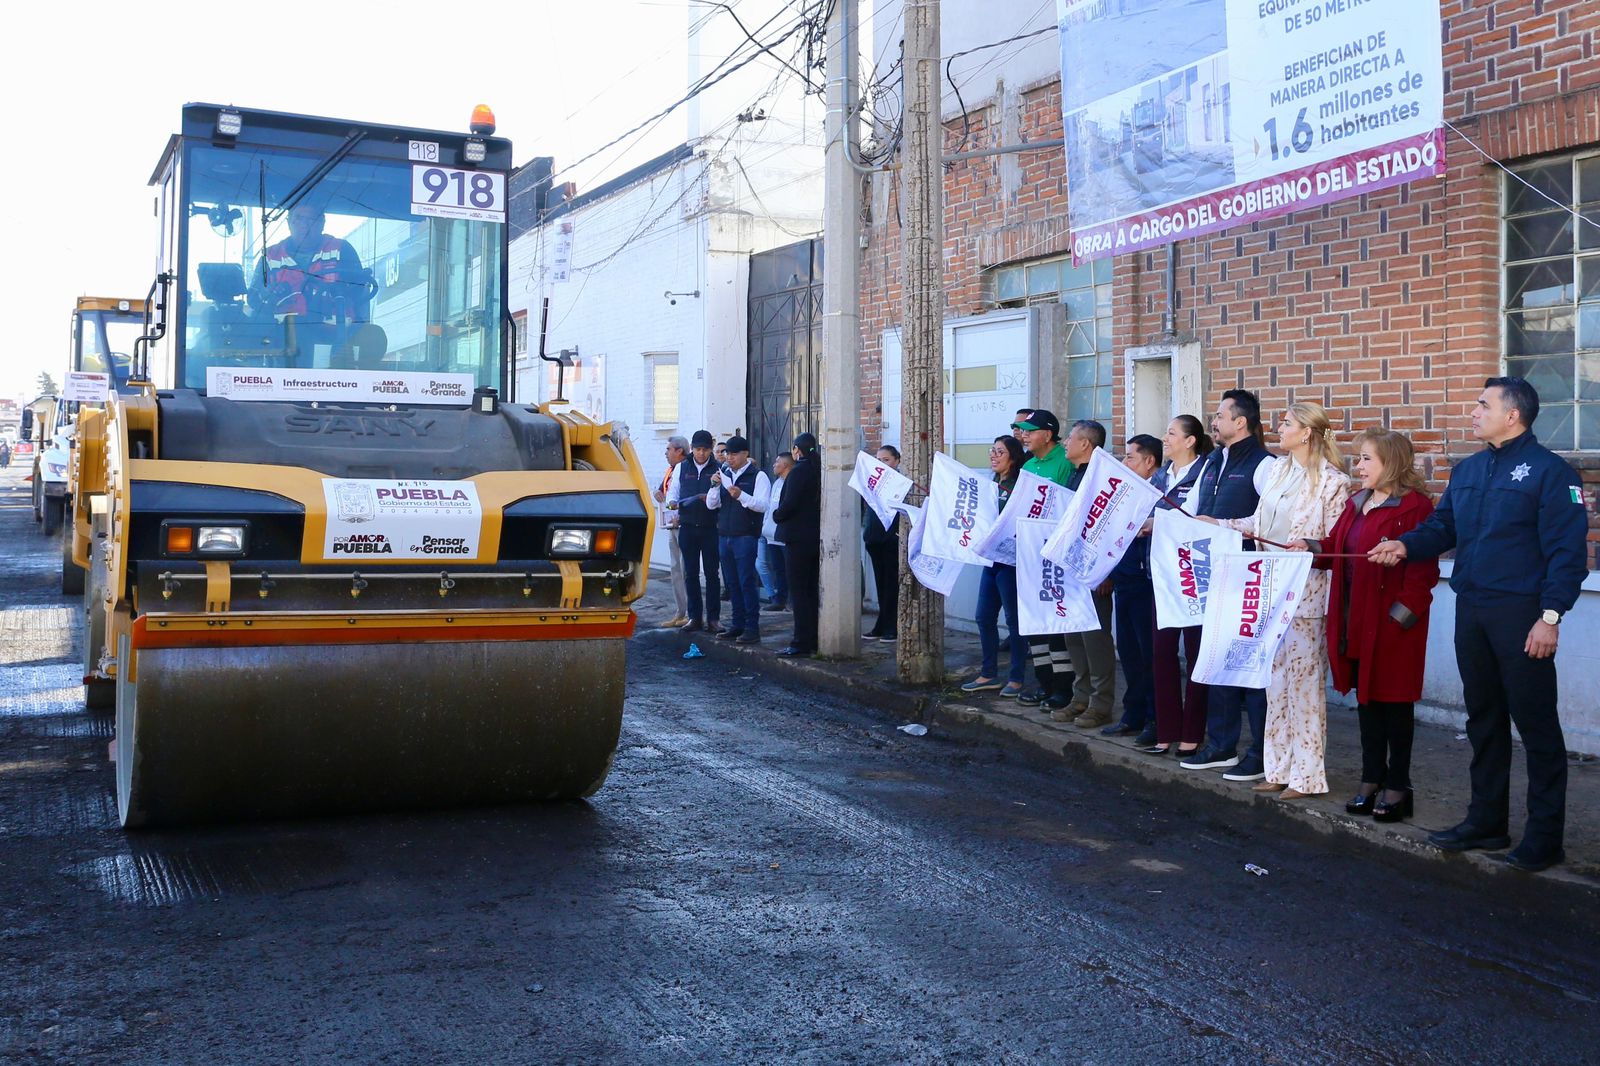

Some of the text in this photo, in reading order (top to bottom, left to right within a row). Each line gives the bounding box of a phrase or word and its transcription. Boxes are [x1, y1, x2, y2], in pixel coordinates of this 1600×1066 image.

[1285, 13, 1302, 33] DE
[1305, 5, 1322, 25] 50
[1284, 31, 1387, 81] BENEFICIAN DE
[1270, 48, 1405, 107] MANERA DIRECTA A
[1319, 71, 1423, 119] millones de
[1263, 107, 1313, 161] 1.6
[1321, 101, 1420, 144] habitantes
[411, 142, 437, 160] 918
[422, 168, 495, 209] 918
[1075, 142, 1437, 258] OBRA A CARGO DEL GOBIERNO DEL ESTADO
[233, 375, 273, 384] PUEBLA
[282, 378, 358, 388] Infraestructura
[372, 386, 410, 394] PUEBLA
[429, 380, 462, 389] Pensar
[431, 387, 467, 397] Grande
[284, 413, 436, 437] SANY
[376, 488, 469, 501] PUEBLA
[948, 476, 968, 530] Pensar
[962, 477, 979, 530] Grande
[1081, 477, 1122, 540] PUEBLA
[1086, 482, 1128, 544] Gobierno del Estado
[332, 543, 393, 554] PUEBLA
[348, 535, 385, 543] AMOR
[422, 535, 466, 545] Pensar
[423, 544, 470, 554] Grande
[1178, 547, 1198, 599] AMOR
[1187, 597, 1200, 616] POR
[1239, 558, 1263, 638] PUEBLA
[1254, 600, 1268, 639] Gobierno
[1262, 558, 1271, 588] Estado
